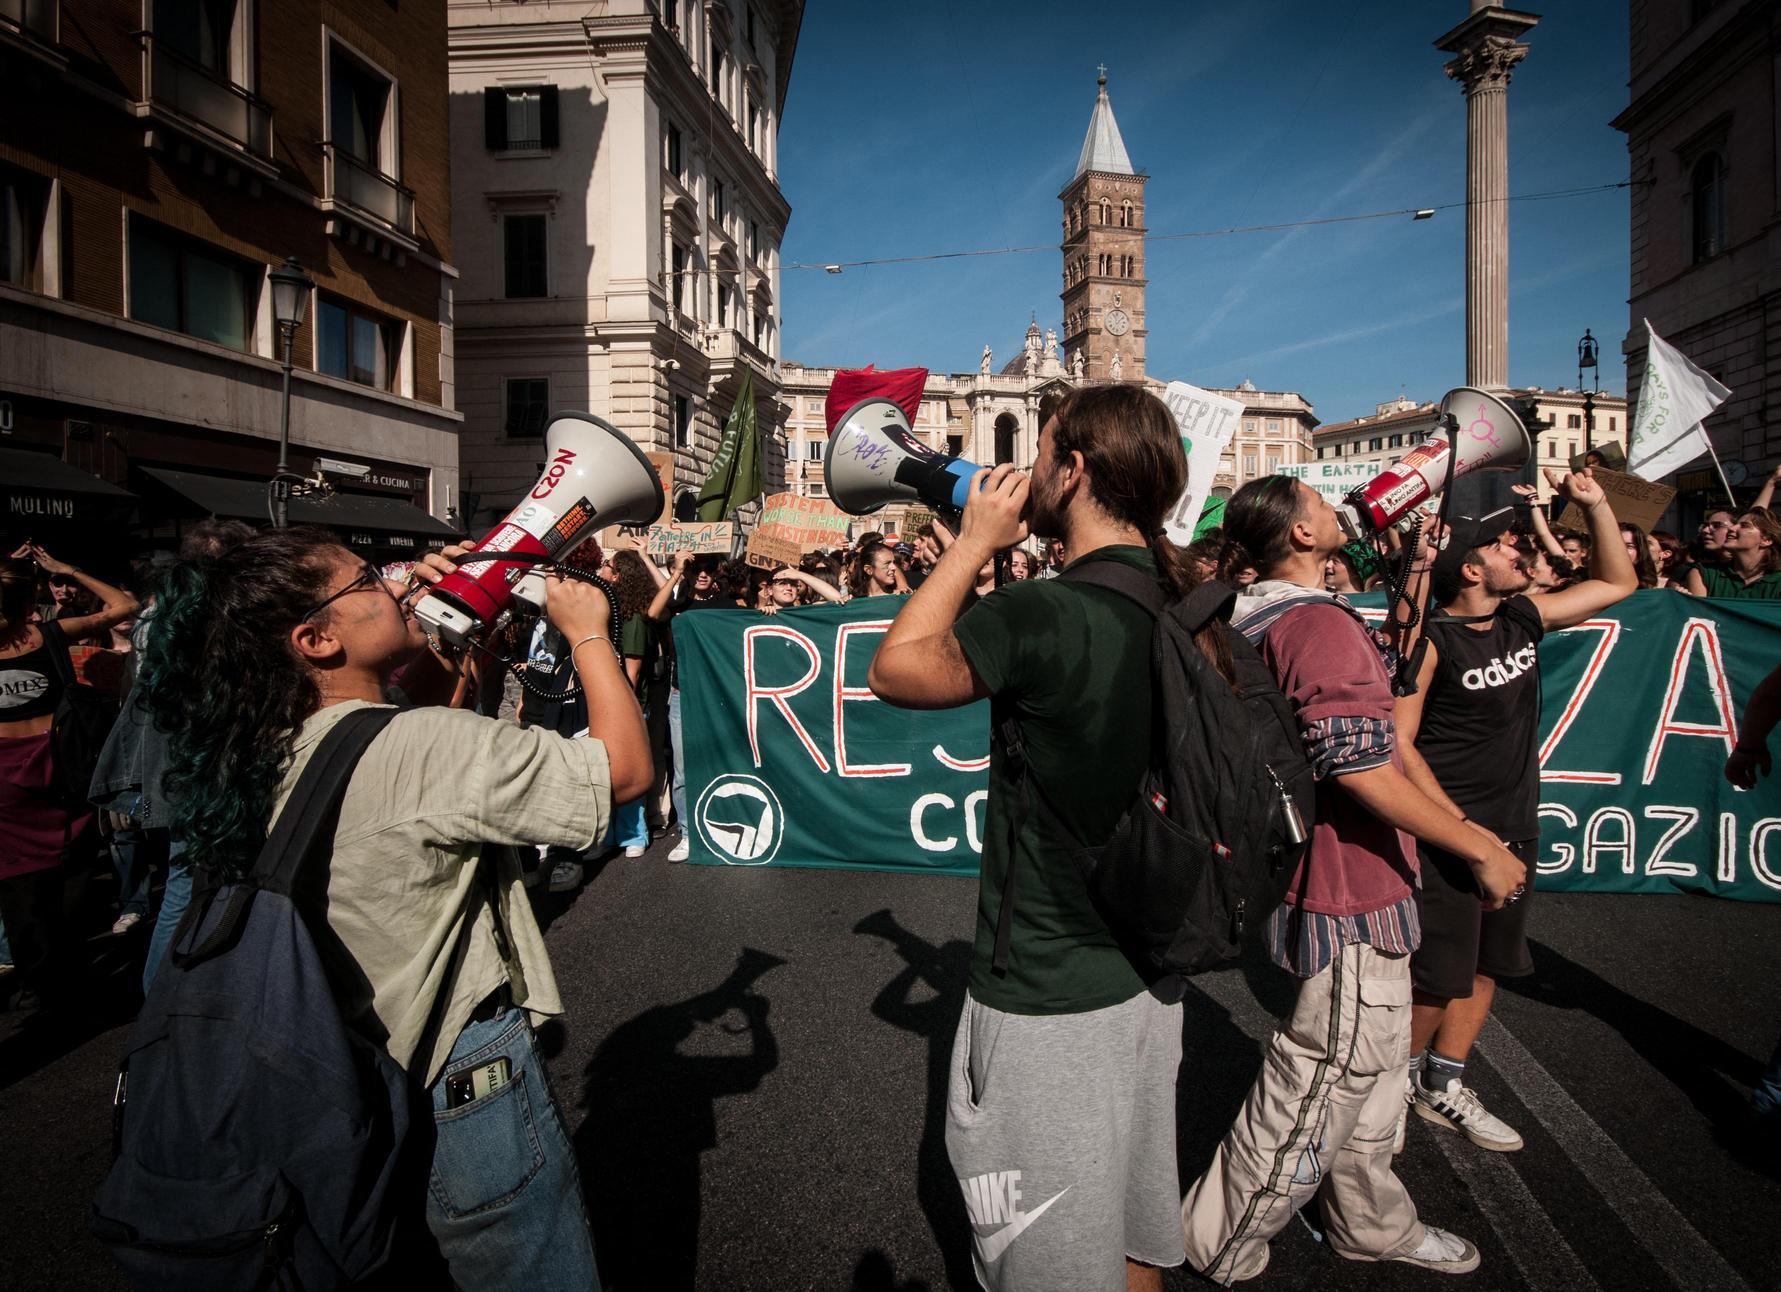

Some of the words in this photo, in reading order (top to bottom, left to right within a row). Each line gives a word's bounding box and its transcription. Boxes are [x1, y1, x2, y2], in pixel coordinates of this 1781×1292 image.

[1206, 406, 1234, 439] IT
[1278, 466, 1308, 483] THE
[1322, 463, 1380, 478] EARTH
[380, 476, 410, 489] CUCINA
[807, 514, 849, 531] THAN
[701, 530, 712, 542] IN
[959, 1169, 1025, 1225] NIKE
